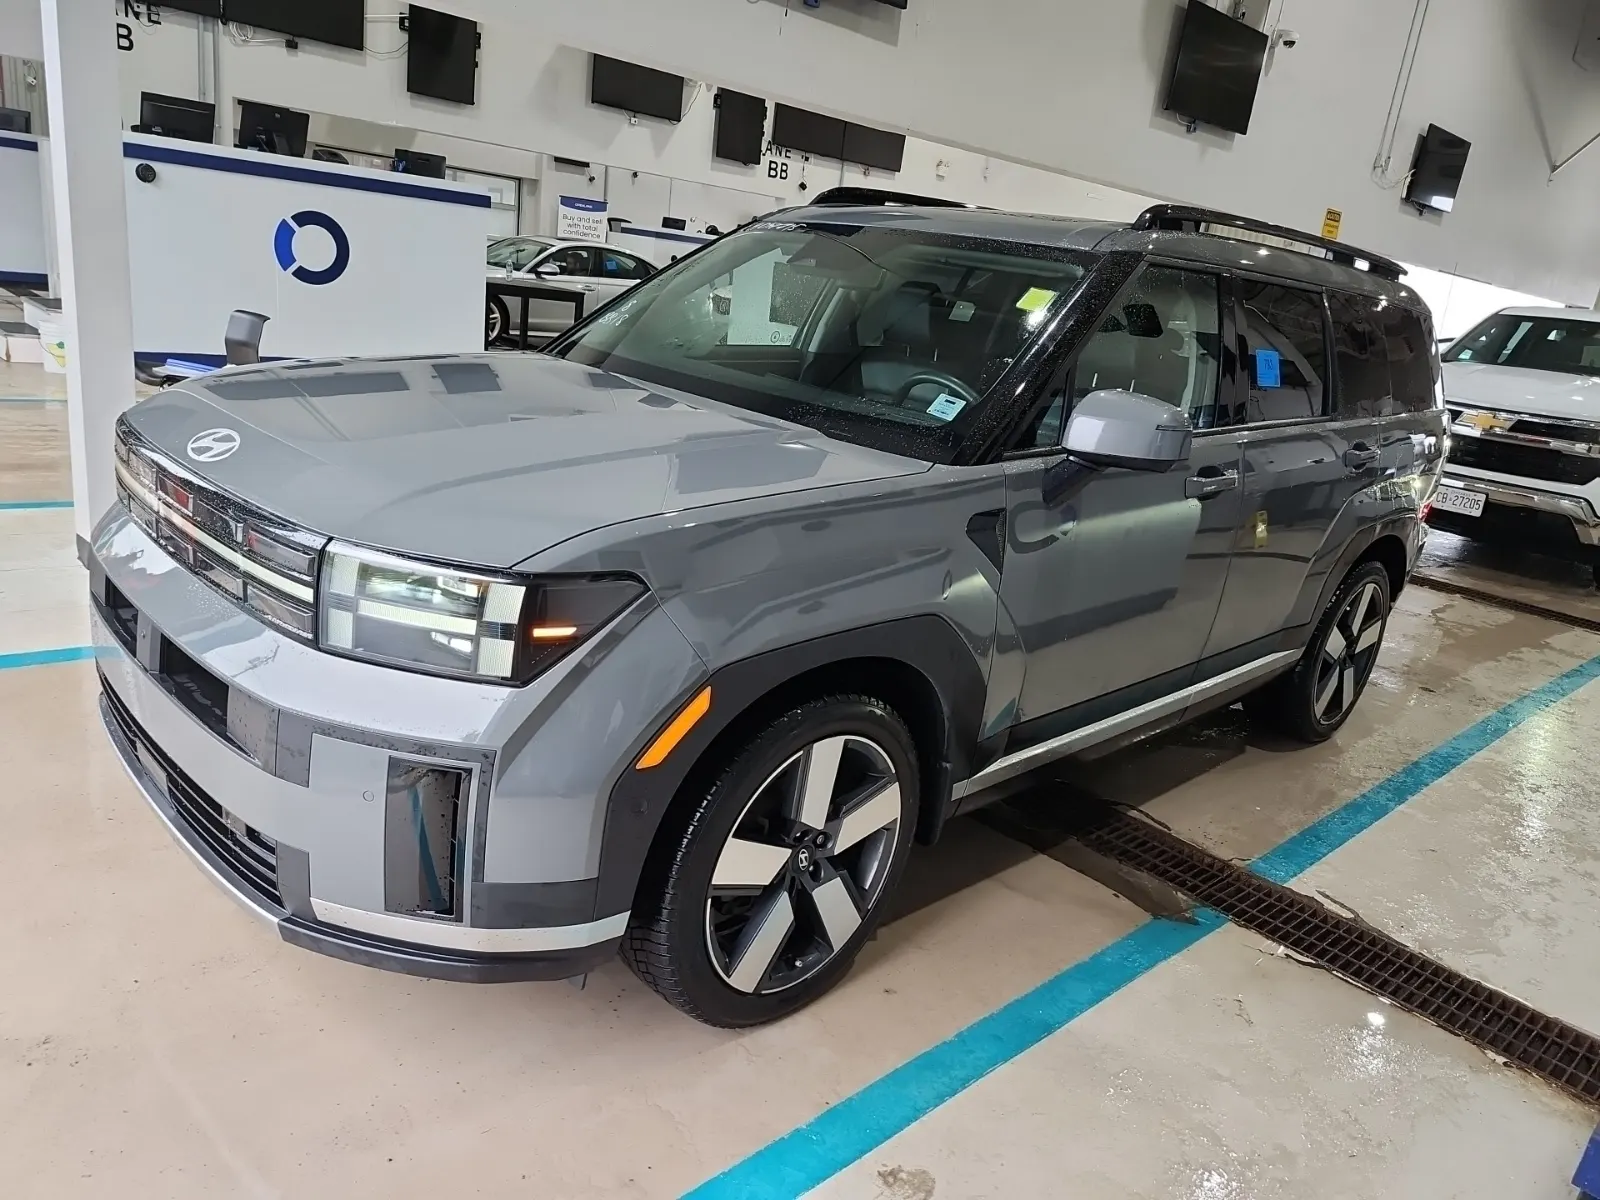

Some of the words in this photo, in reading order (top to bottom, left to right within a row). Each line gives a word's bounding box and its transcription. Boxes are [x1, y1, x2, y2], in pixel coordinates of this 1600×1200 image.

[761, 140, 792, 159] ANE
[768, 159, 788, 180] BB
[563, 229, 600, 238] confidence
[582, 224, 599, 232] total
[1436, 492, 1448, 503] CB
[1452, 495, 1482, 510] 27205
